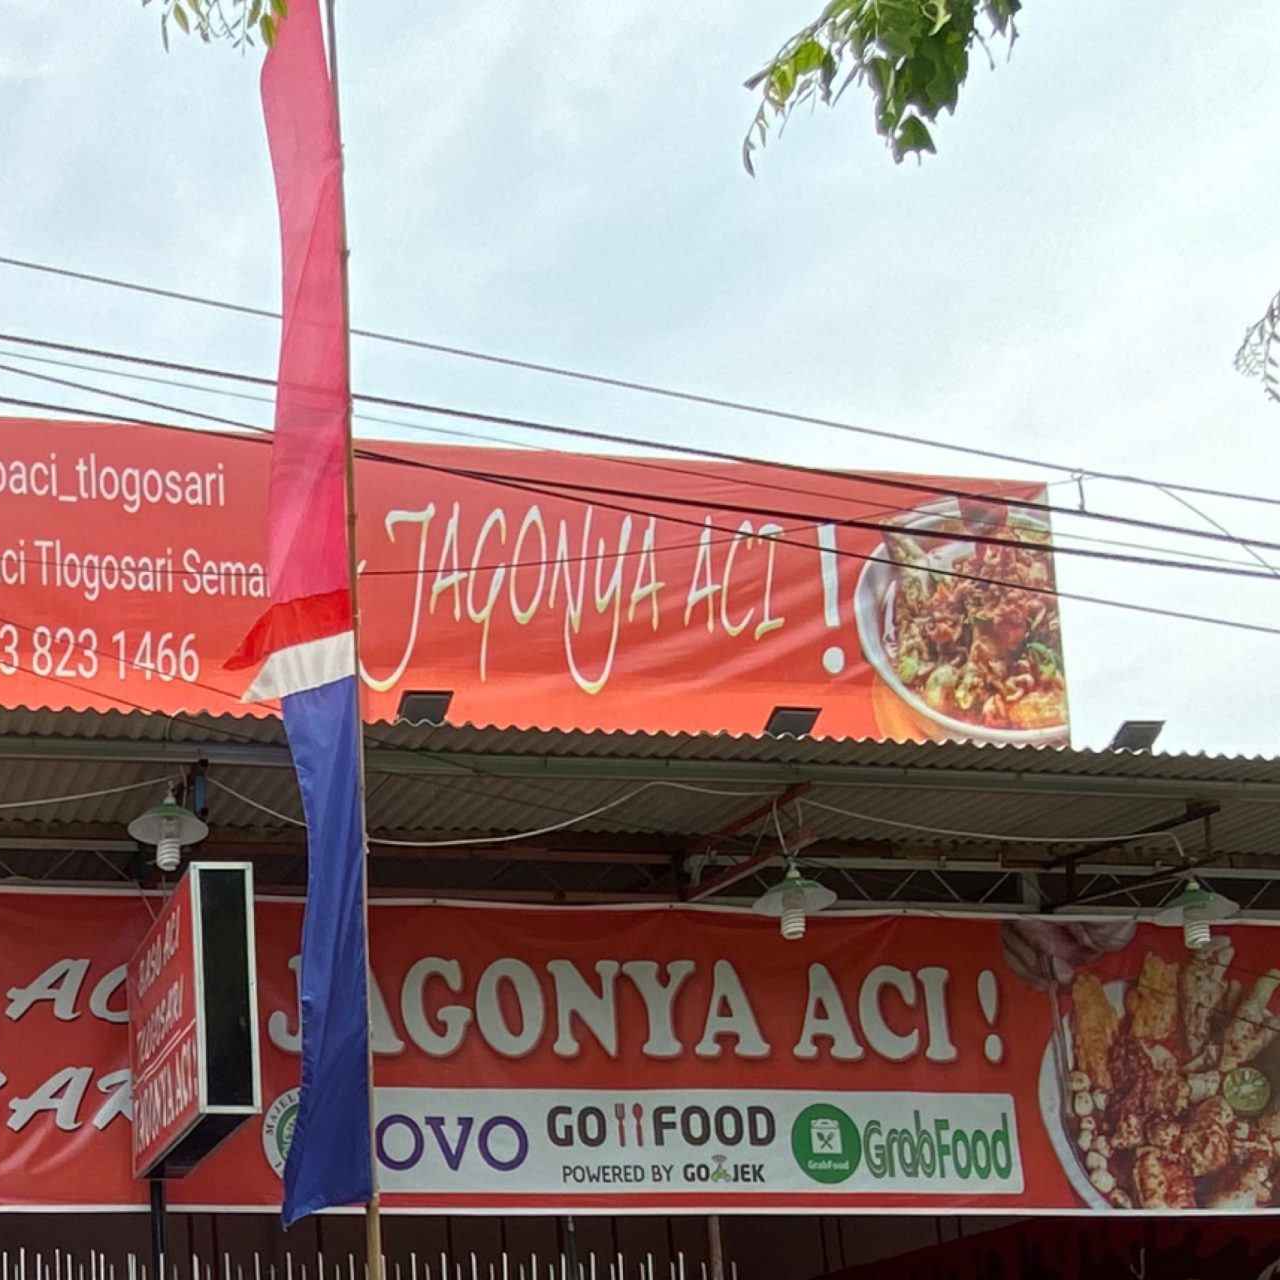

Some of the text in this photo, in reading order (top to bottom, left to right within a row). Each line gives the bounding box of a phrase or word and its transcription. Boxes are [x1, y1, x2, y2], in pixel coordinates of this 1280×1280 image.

[35, 540, 174, 601] Tlogosari
[357, 501, 666, 694] JAGONYA
[684, 514, 785, 641] ACI
[32, 626, 99, 679] 823
[112, 630, 200, 682] 1466
[3, 957, 130, 1023] AC
[793, 962, 957, 1063] ACI
[375, 1114, 530, 1171] OVO
[807, 1159, 850, 1171] GrabFood
[863, 1109, 1013, 1180] GrabFood
[562, 1164, 645, 1183] POWERED
[651, 1164, 673, 1183] BY
